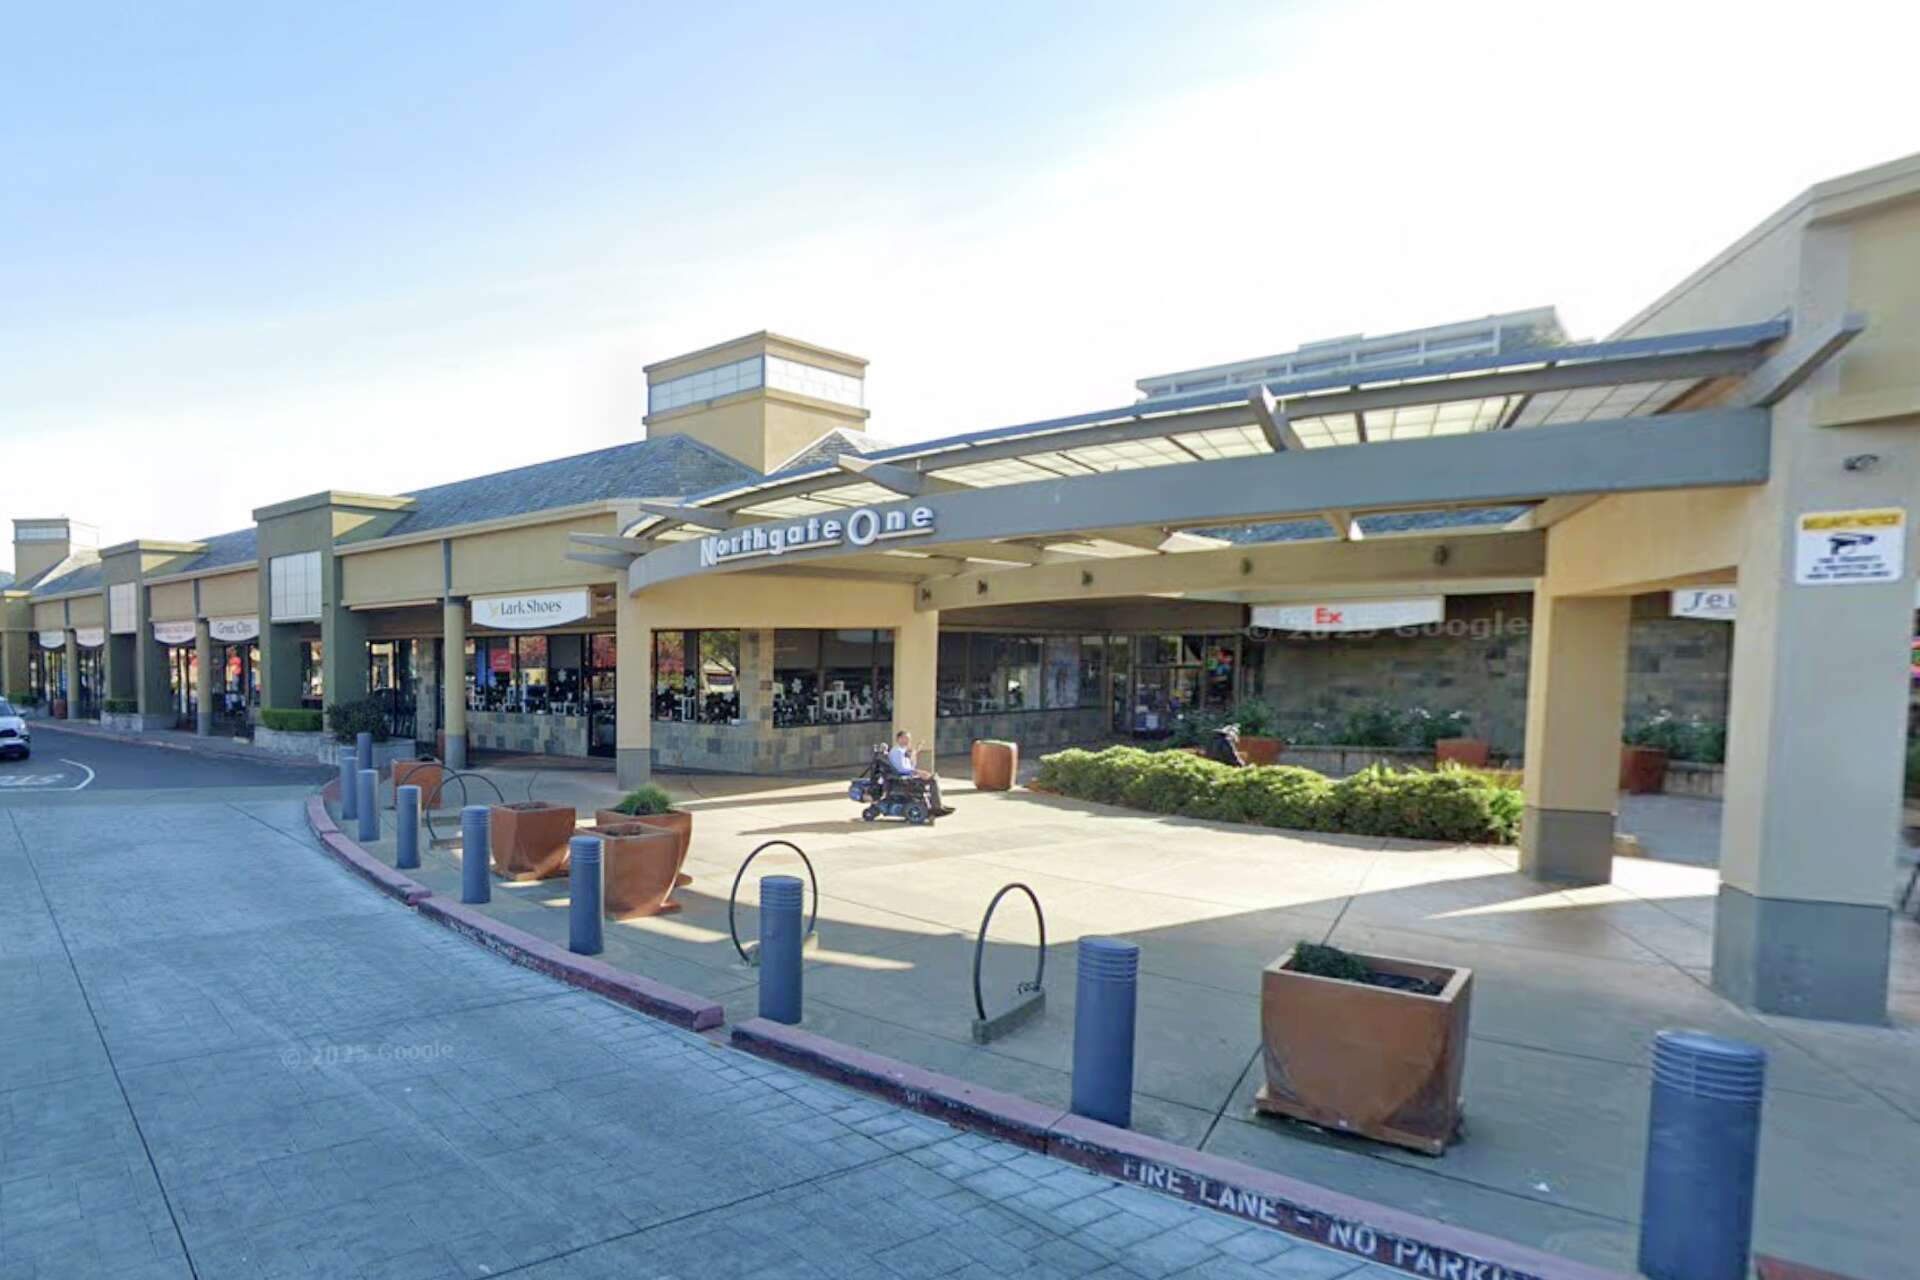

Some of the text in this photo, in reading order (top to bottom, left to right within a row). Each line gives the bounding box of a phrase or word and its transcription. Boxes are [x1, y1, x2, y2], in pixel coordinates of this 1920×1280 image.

[700, 506, 934, 567] Northgate One
[501, 598, 562, 616] Lark Shoes
[1123, 1158, 1185, 1195] FIRE
[1199, 1179, 1280, 1225] LANE
[1329, 1220, 1378, 1256] NO
